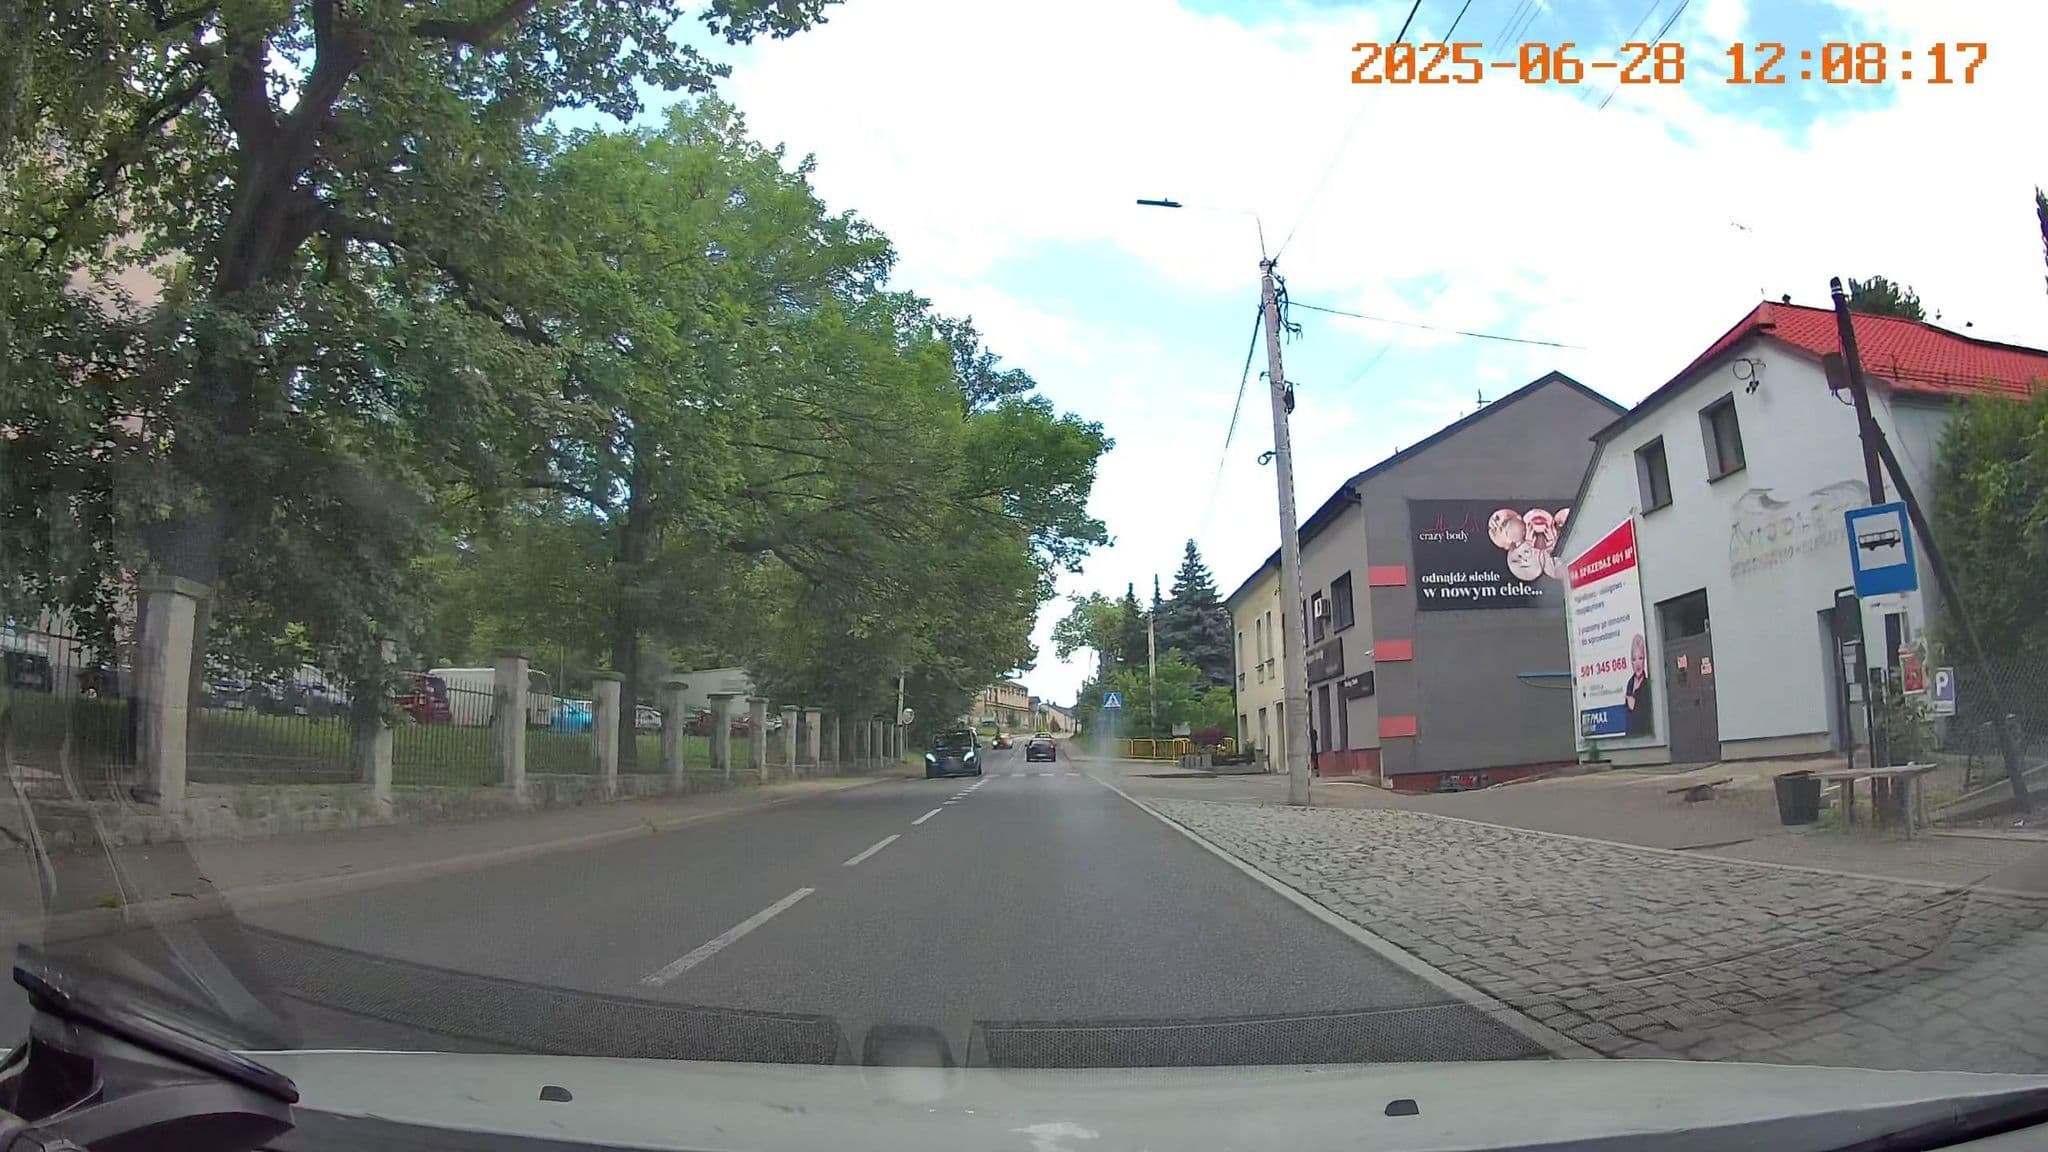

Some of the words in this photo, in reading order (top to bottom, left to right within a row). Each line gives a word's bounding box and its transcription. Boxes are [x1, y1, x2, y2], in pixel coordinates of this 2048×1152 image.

[1419, 531, 1444, 543] crazy
[1445, 530, 1469, 543] body
[1421, 571, 1467, 585] odnajdź
[1468, 570, 1501, 582] siebie
[1440, 585, 1497, 601] nowym
[1581, 664, 1594, 678] 501
[1596, 660, 1610, 675] 345
[1611, 657, 1628, 672] 068
[1935, 671, 1949, 697] P
